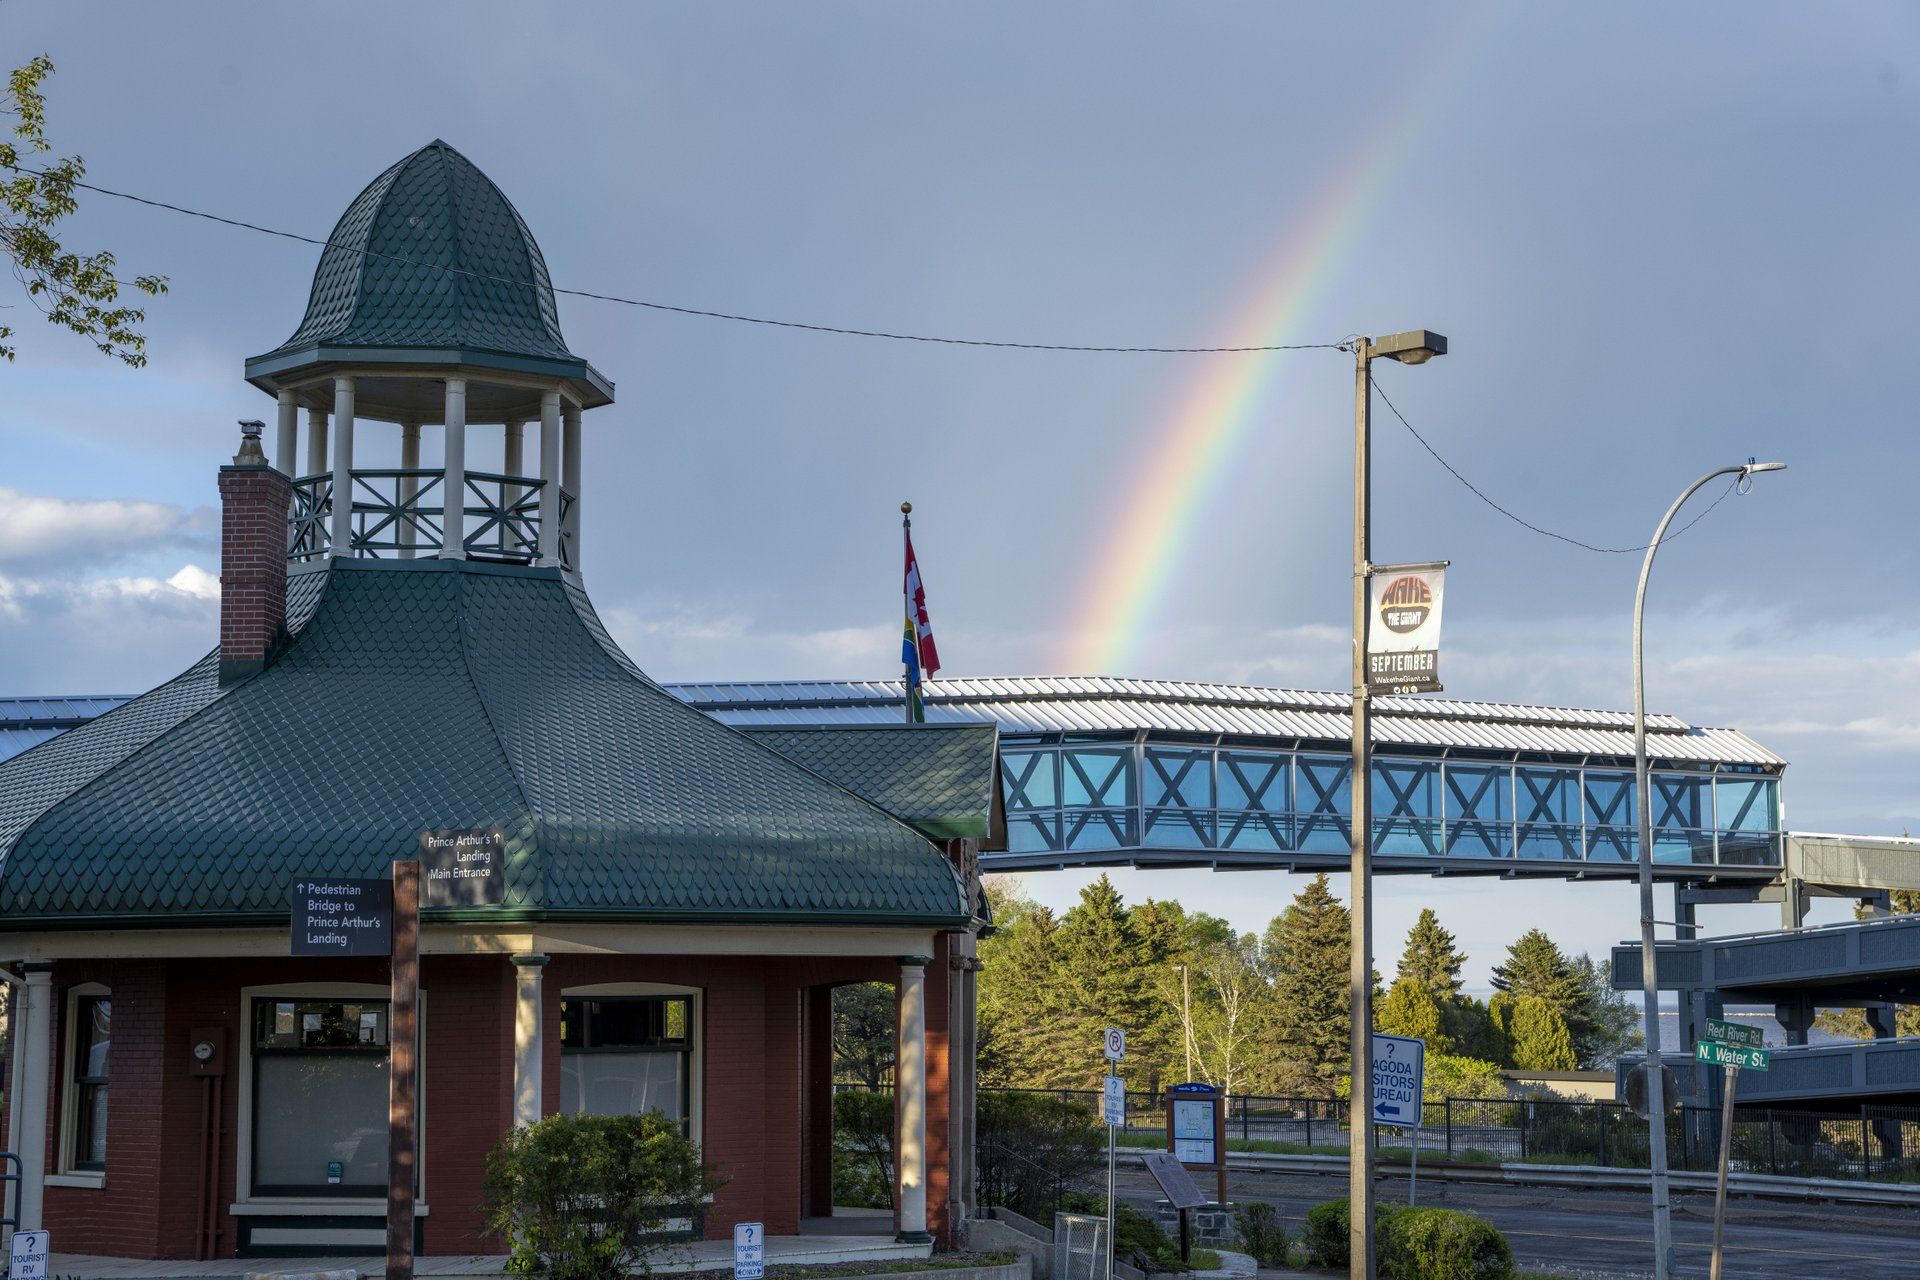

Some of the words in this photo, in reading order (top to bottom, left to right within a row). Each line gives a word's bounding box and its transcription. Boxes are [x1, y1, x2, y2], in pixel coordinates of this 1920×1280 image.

[1381, 577, 1432, 605] WAKE
[1388, 613, 1400, 626] THE
[1400, 611, 1422, 626] GIANT
[1371, 653, 1434, 673] SEPTEMBER
[1375, 675, 1431, 684] WaketheGiant.ca
[428, 837, 454, 847] Prince
[456, 835, 490, 846] Arthur's
[456, 851, 491, 863] Landing
[430, 868, 451, 879] Main
[453, 867, 490, 879] Entrance
[307, 883, 361, 895] Pedestrian
[307, 900, 342, 913] Bridge
[343, 901, 355, 912] to
[307, 916, 339, 928] Prince
[341, 916, 381, 928] Arthur's
[307, 932, 347, 946] Landing
[1707, 1023, 1725, 1038] Red
[1727, 1026, 1748, 1042] River
[1699, 1045, 1710, 1060] N.
[1716, 1047, 1748, 1065] Water
[1751, 1052, 1766, 1067] St.
[1373, 1059, 1412, 1075] AGODA
[1373, 1073, 1415, 1090] SITORS
[1373, 1087, 1412, 1103] UREAU
[13, 1253, 45, 1263] TOURIST
[736, 1260, 762, 1268] PARKING
[22, 1265, 34, 1275] RV
